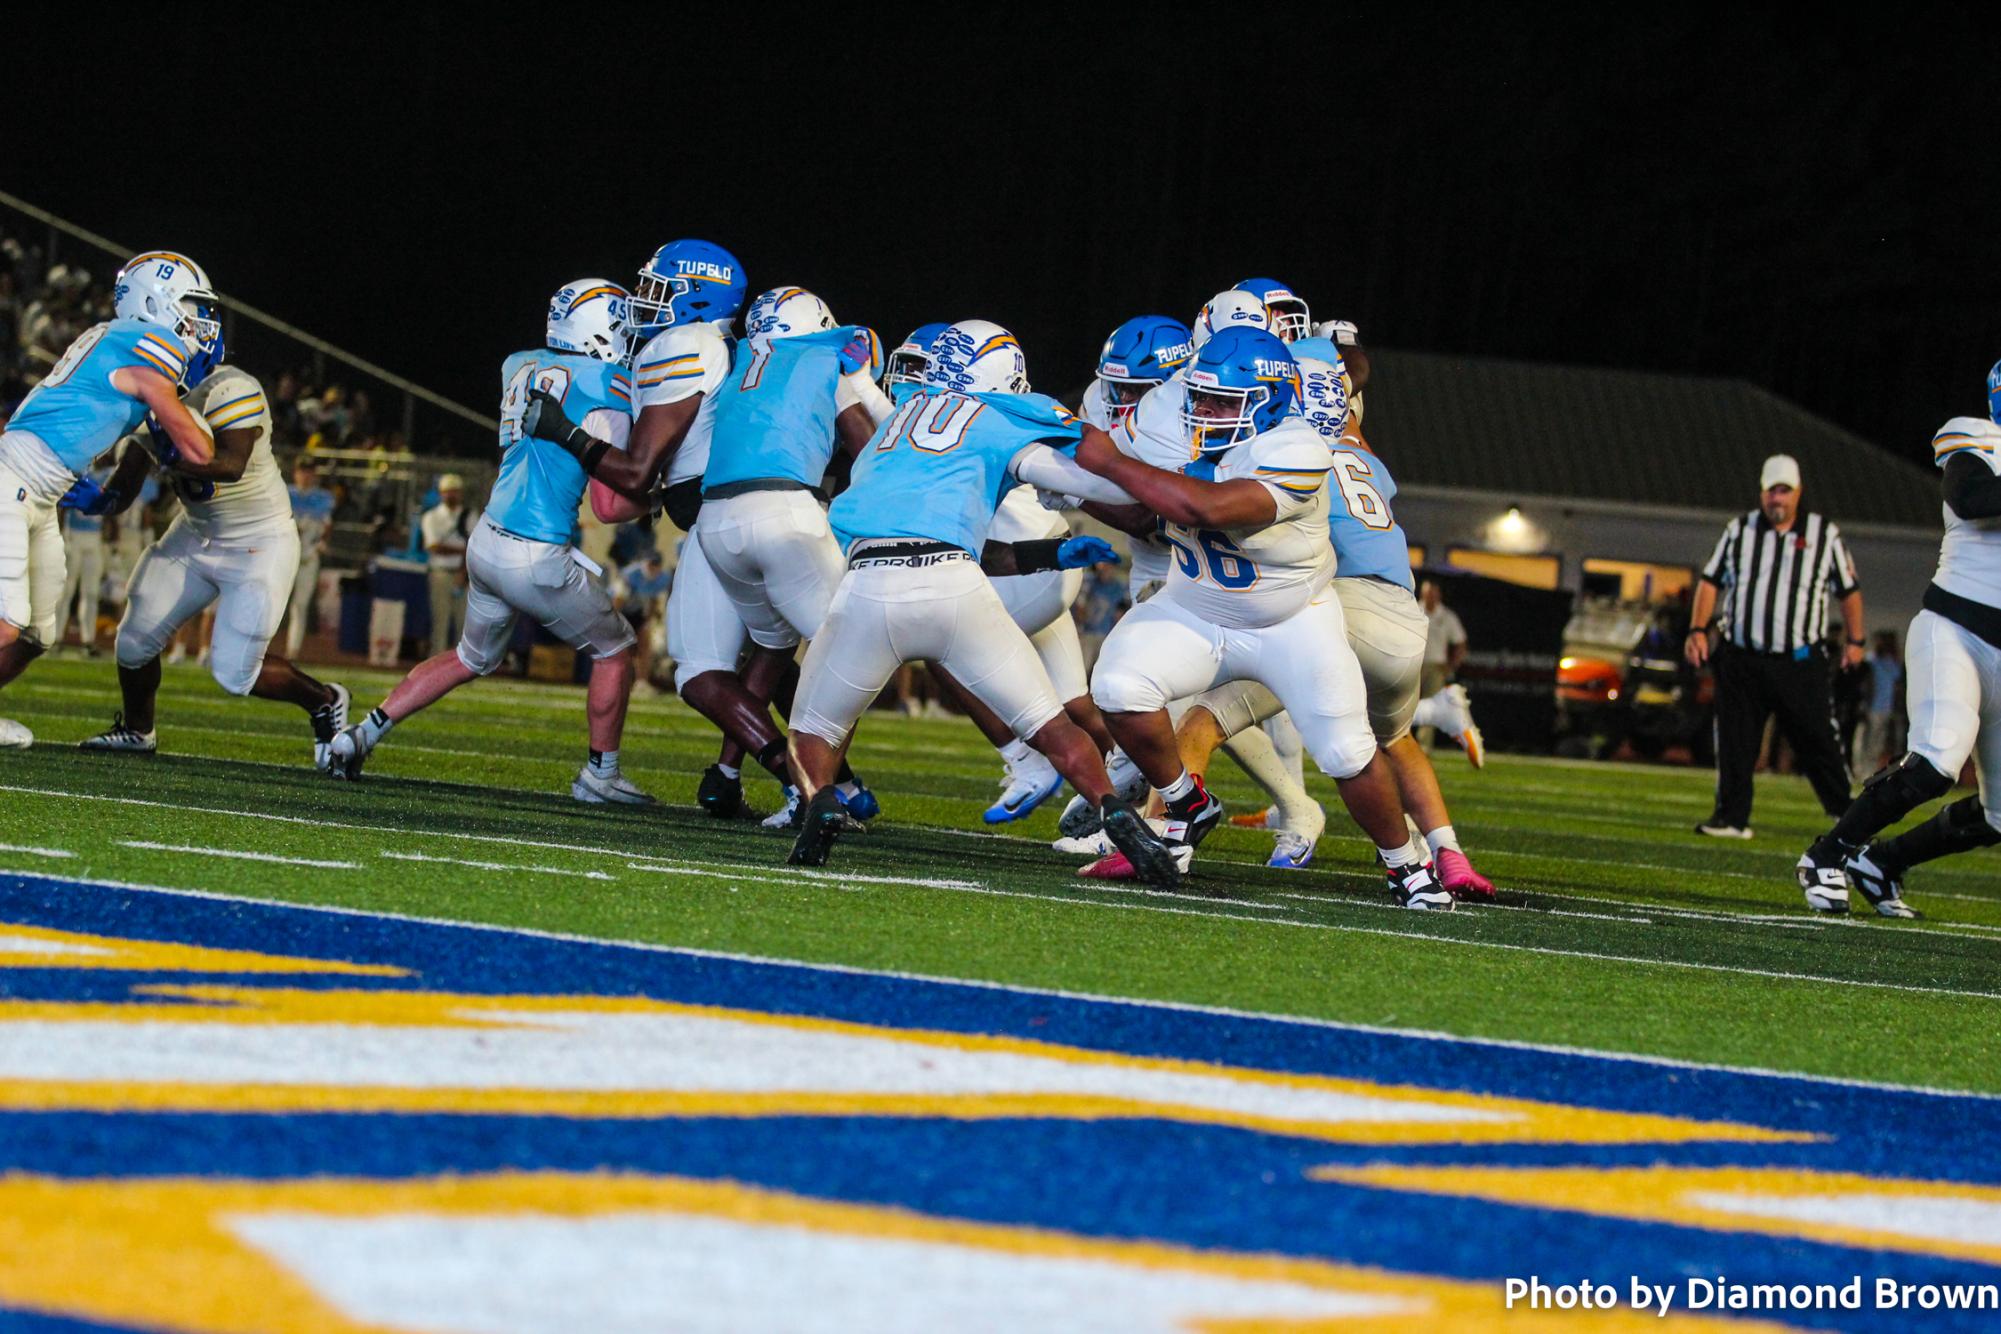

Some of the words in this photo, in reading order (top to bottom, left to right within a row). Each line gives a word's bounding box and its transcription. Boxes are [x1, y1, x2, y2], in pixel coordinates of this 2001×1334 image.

[156, 264, 175, 280] 19
[677, 260, 731, 280] TUPELO
[1014, 352, 1024, 373] 10
[877, 390, 987, 456] 10
